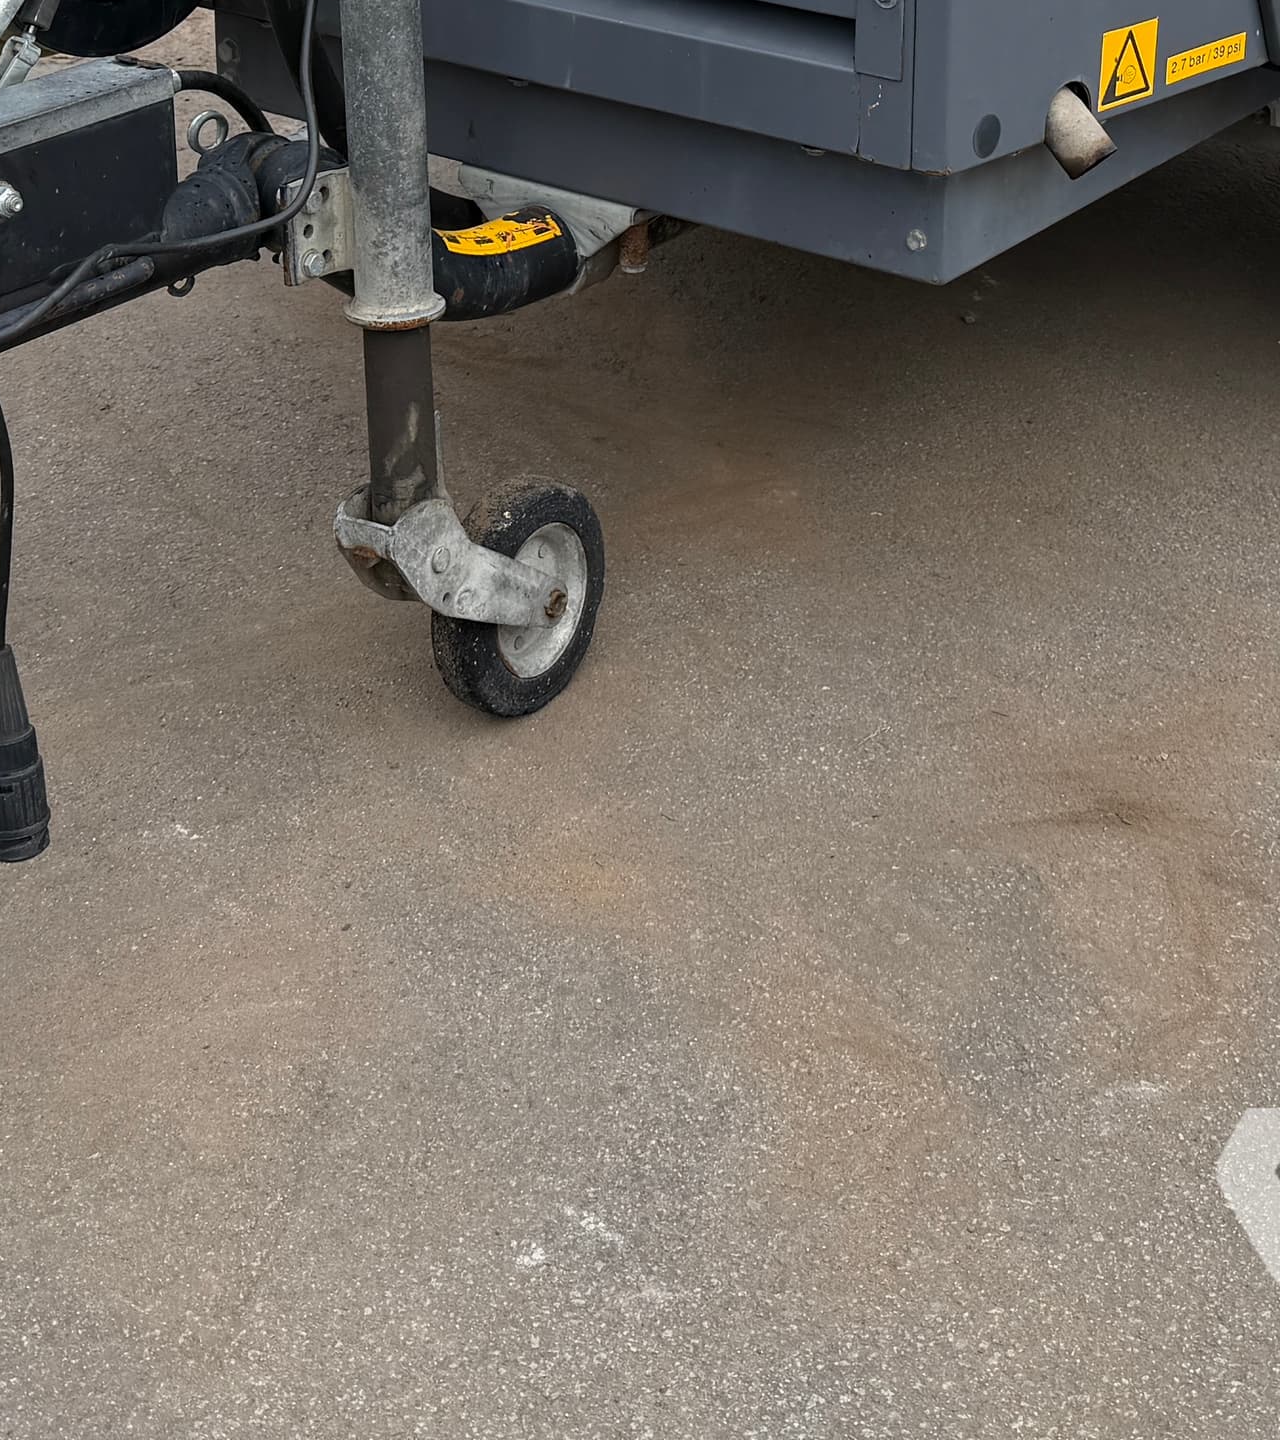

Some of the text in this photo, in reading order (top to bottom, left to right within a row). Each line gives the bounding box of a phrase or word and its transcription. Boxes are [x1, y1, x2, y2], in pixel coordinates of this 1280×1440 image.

[1171, 57, 1187, 74] 2.7
[1188, 53, 1206, 68] bar
[1213, 46, 1225, 60] 39
[1227, 40, 1242, 59] psi
